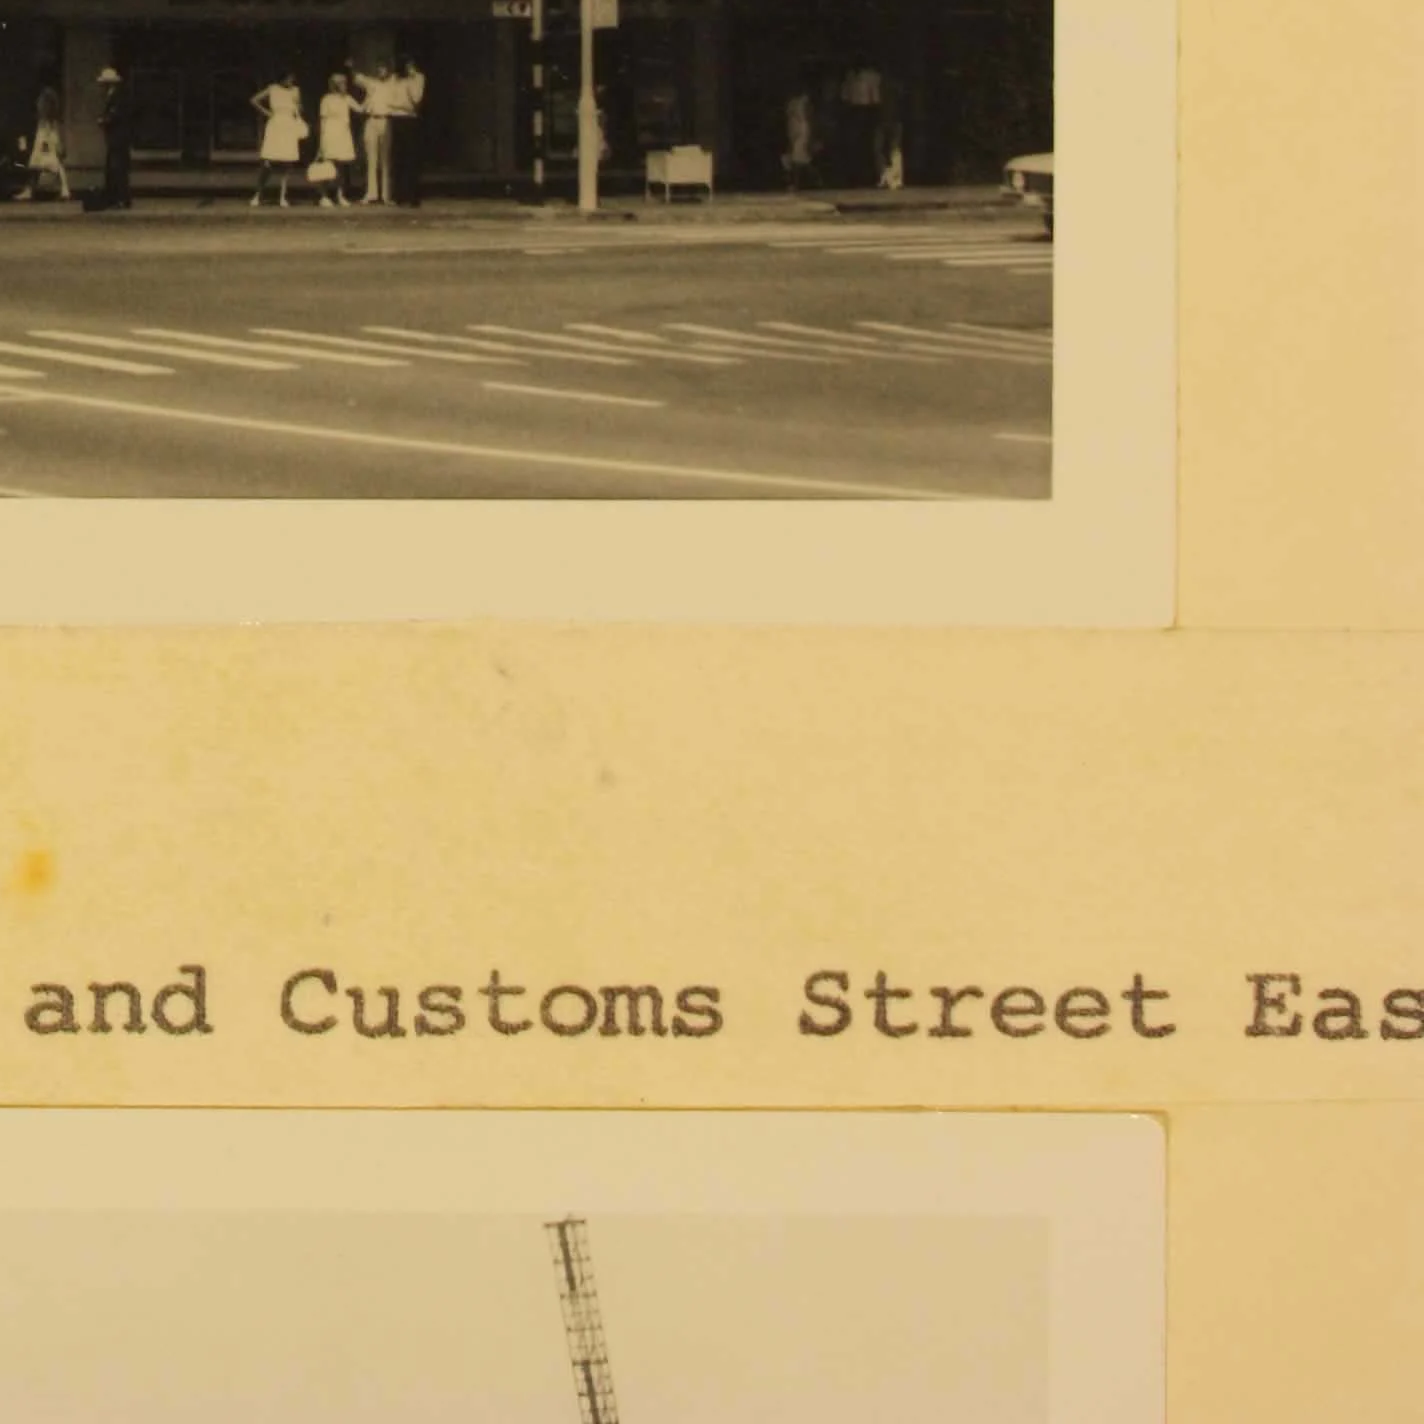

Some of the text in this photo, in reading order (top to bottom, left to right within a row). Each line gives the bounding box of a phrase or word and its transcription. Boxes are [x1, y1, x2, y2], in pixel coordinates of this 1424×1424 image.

[23, 963, 214, 1037] and
[279, 967, 724, 1040] Customs
[797, 969, 1176, 1040] Street
[1244, 972, 1424, 1040] Eas
